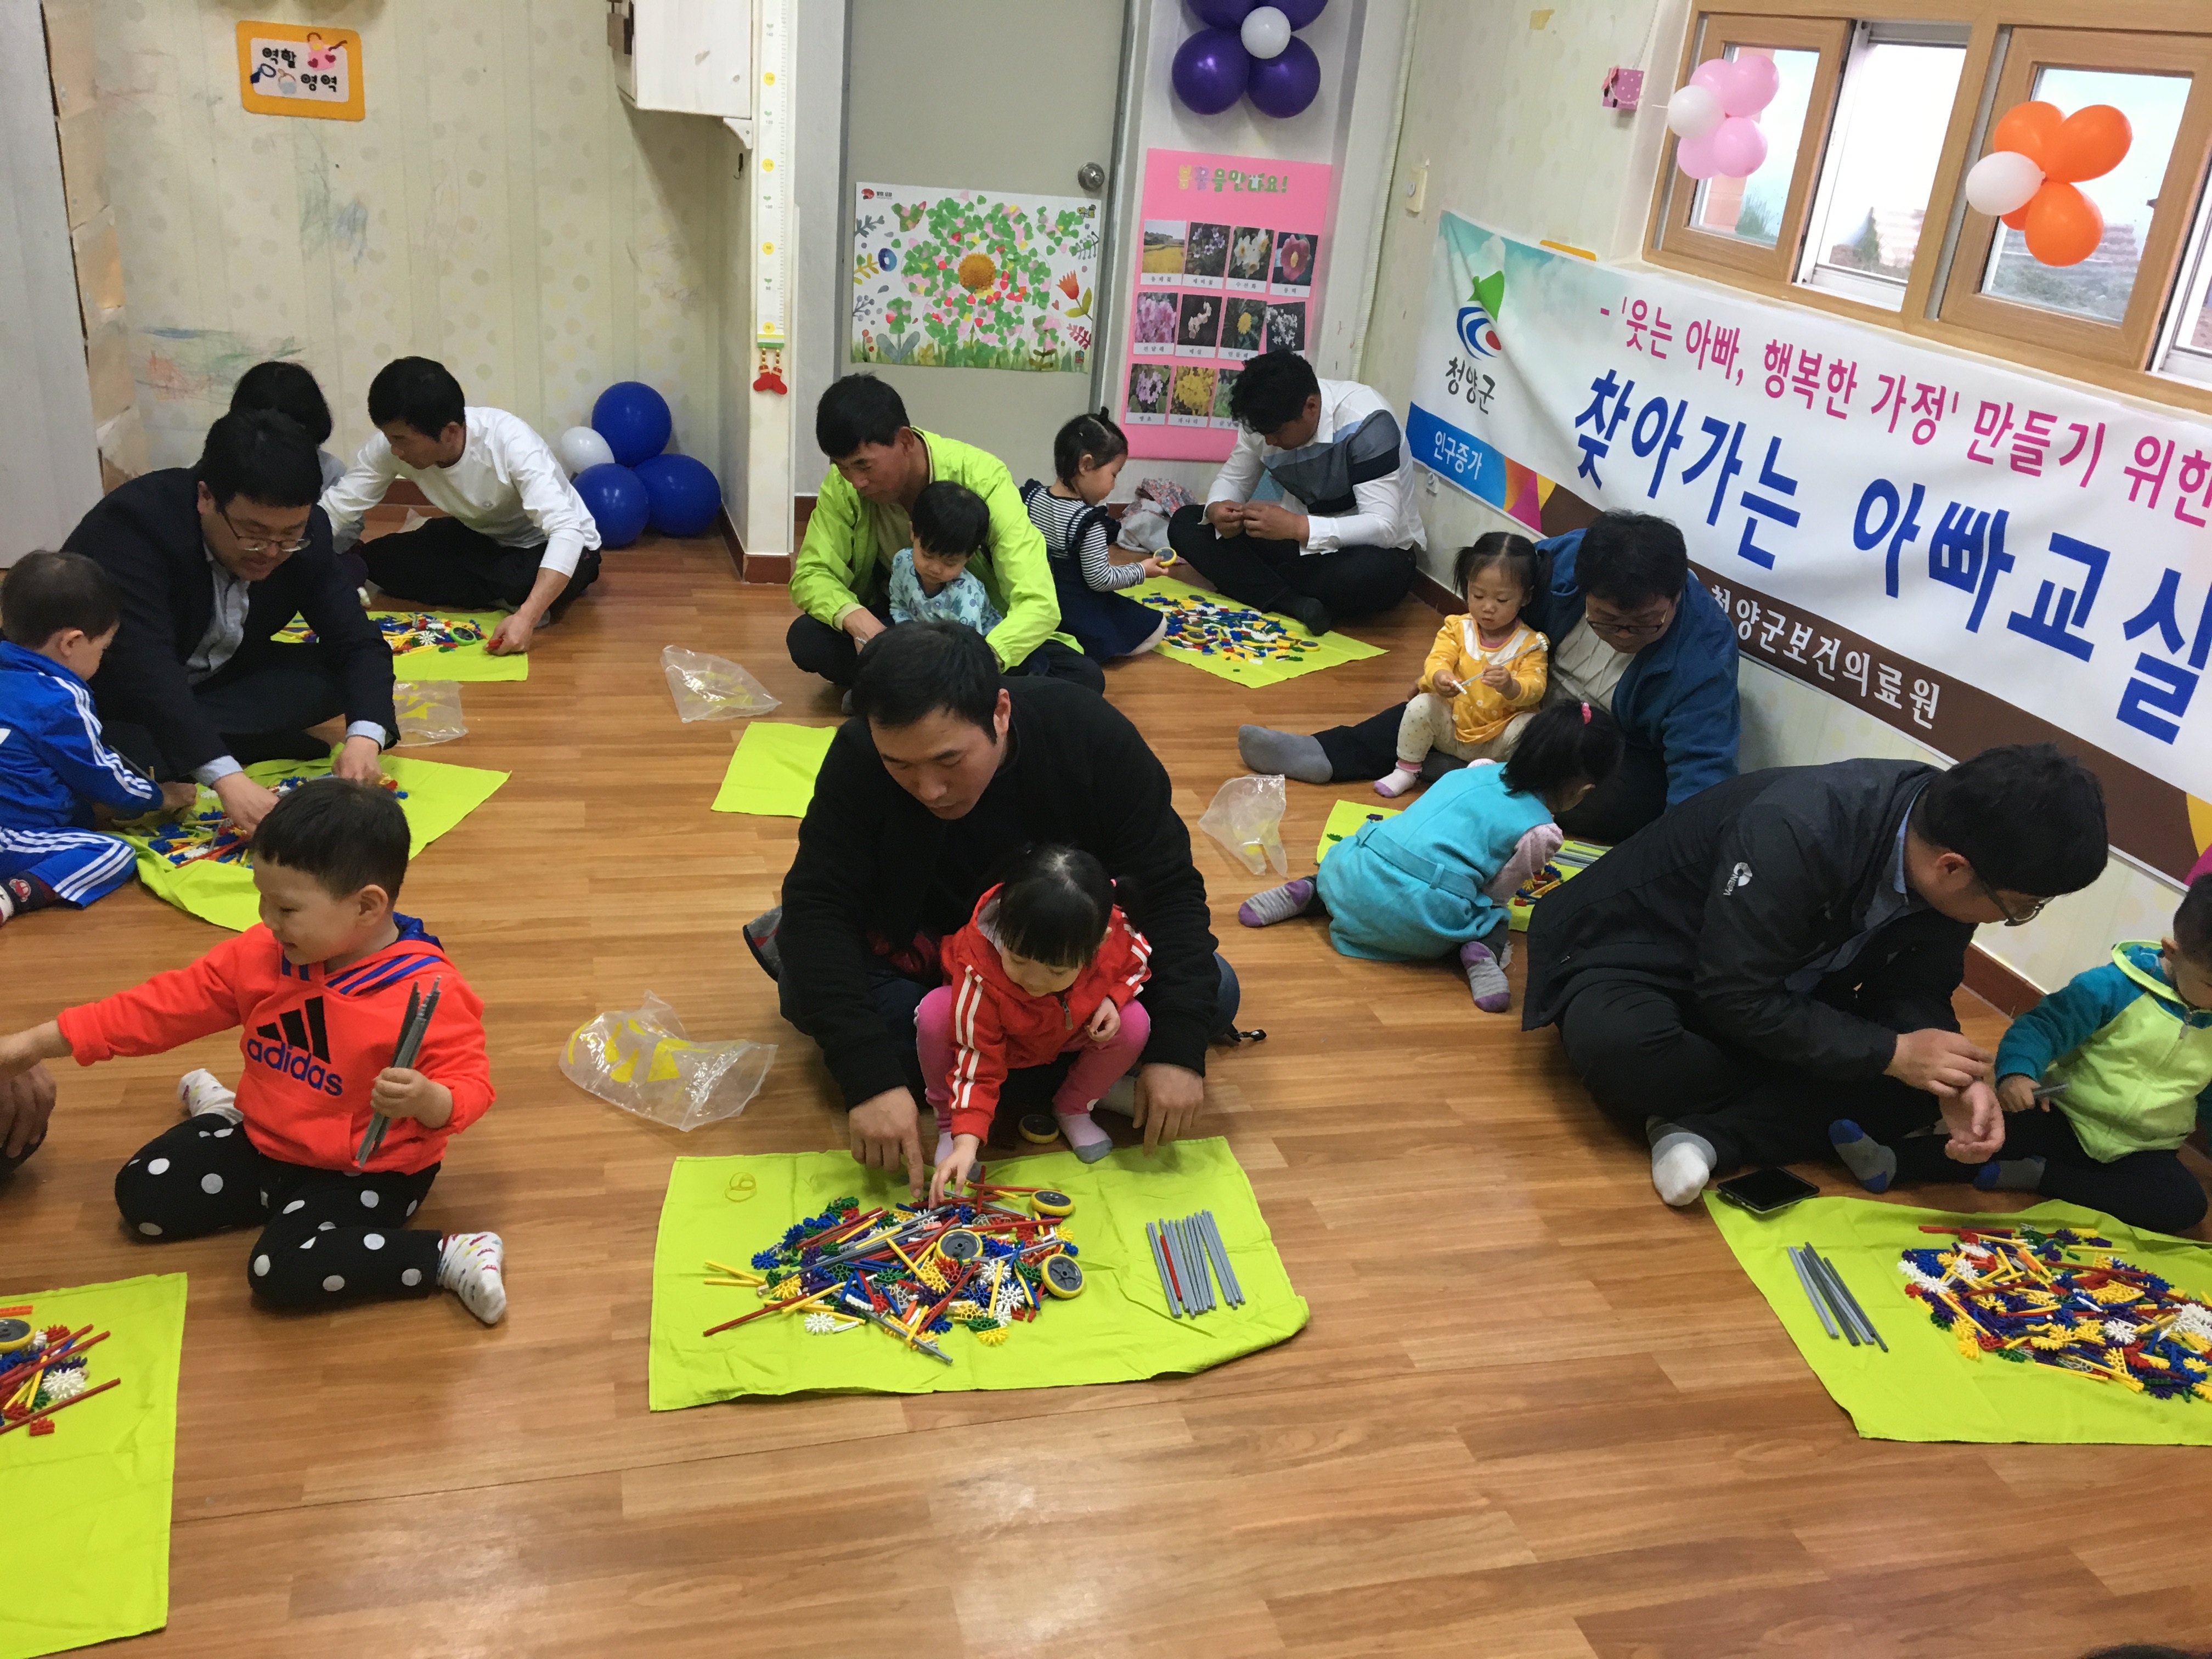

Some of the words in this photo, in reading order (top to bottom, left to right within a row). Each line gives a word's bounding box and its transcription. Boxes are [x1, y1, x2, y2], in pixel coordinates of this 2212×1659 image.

[262, 47, 297, 68] 역할
[301, 74, 337, 92] 영역
[1445, 356, 1496, 415] 청양군
[1686, 319, 1744, 386] 아빠,
[1764, 339, 1858, 420] 행복한
[1967, 400, 2106, 488] 만들기
[2123, 436, 2212, 528] 위한
[1434, 430, 1482, 481] 인구증가
[1575, 369, 1801, 571] 찾아가는
[1853, 478, 2212, 745] 아빠교실
[247, 1038, 343, 1096] adidas
